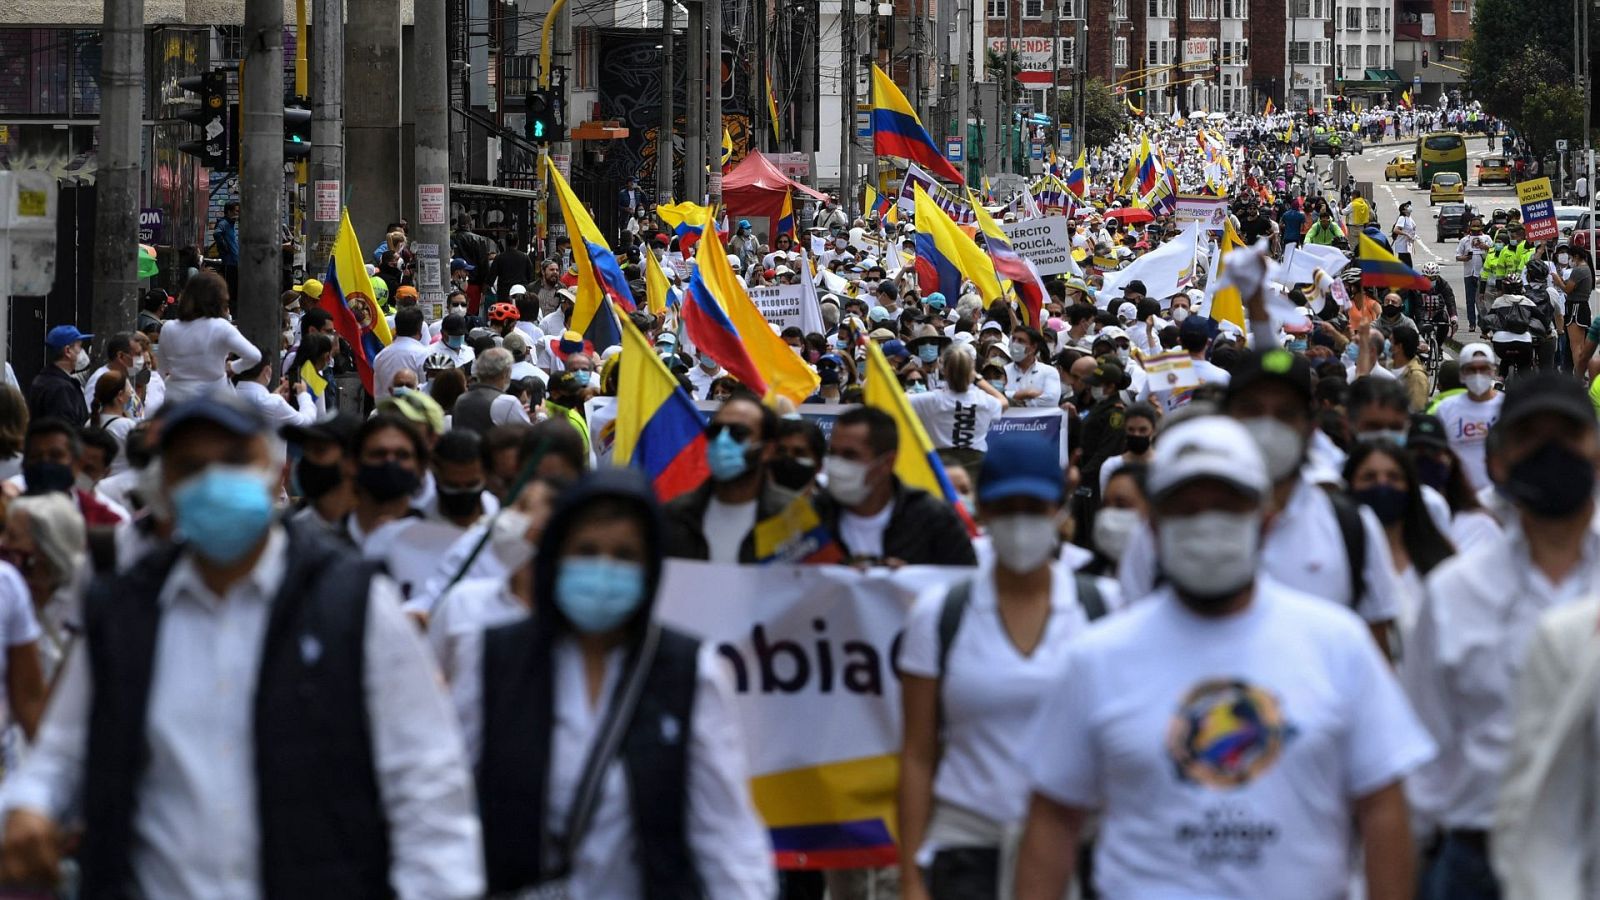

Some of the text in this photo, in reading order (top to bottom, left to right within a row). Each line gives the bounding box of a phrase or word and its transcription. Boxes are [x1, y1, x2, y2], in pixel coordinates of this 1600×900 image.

[992, 40, 1051, 53] SE VENDE
[1522, 191, 1549, 202] VIOLENCIA
[1527, 204, 1536, 212] NO
[1530, 209, 1548, 219] PAROS
[1531, 222, 1539, 230] NO
[1528, 227, 1556, 239] BLOQUEOS
[1012, 237, 1056, 251] POLICÍA,
[760, 289, 780, 297] PARO
[761, 298, 800, 307] BLOQUEOS
[762, 308, 800, 317] VIOLENCIA
